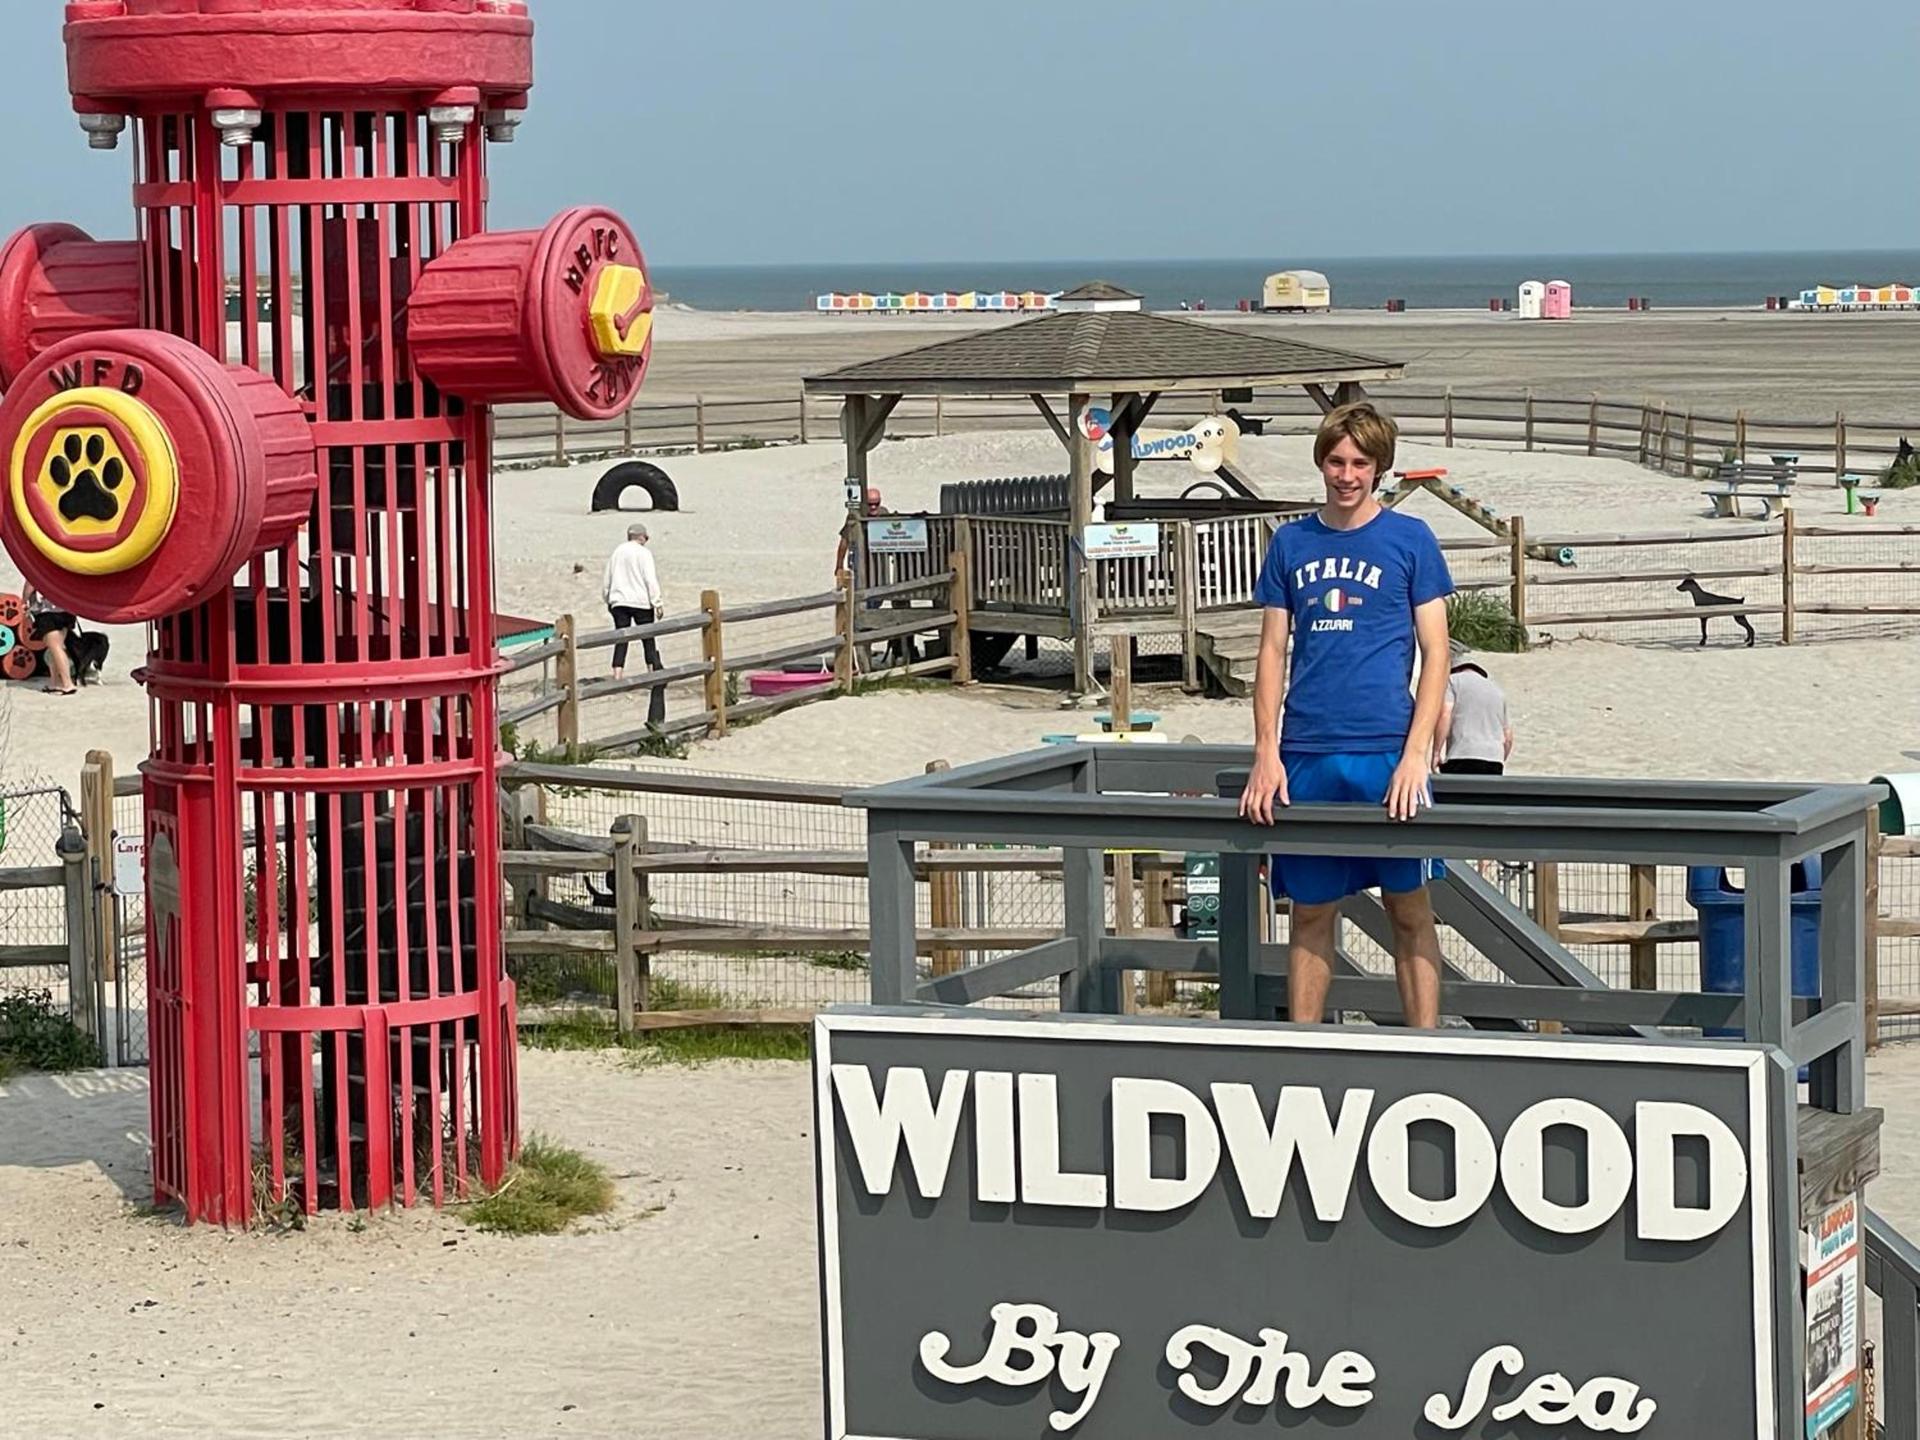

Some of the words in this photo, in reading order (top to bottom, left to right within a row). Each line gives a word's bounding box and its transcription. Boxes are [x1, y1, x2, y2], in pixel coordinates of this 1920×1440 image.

[48, 358, 144, 396] WFD
[1295, 557, 1382, 590] ITALIA
[1311, 619, 1354, 632] AZZURRI
[118, 843, 145, 855] Larg
[831, 1063, 1749, 1242] WILDWOOD
[919, 1302, 1121, 1431] By
[1165, 1323, 1376, 1409] The
[1424, 1344, 1657, 1434] Sea
